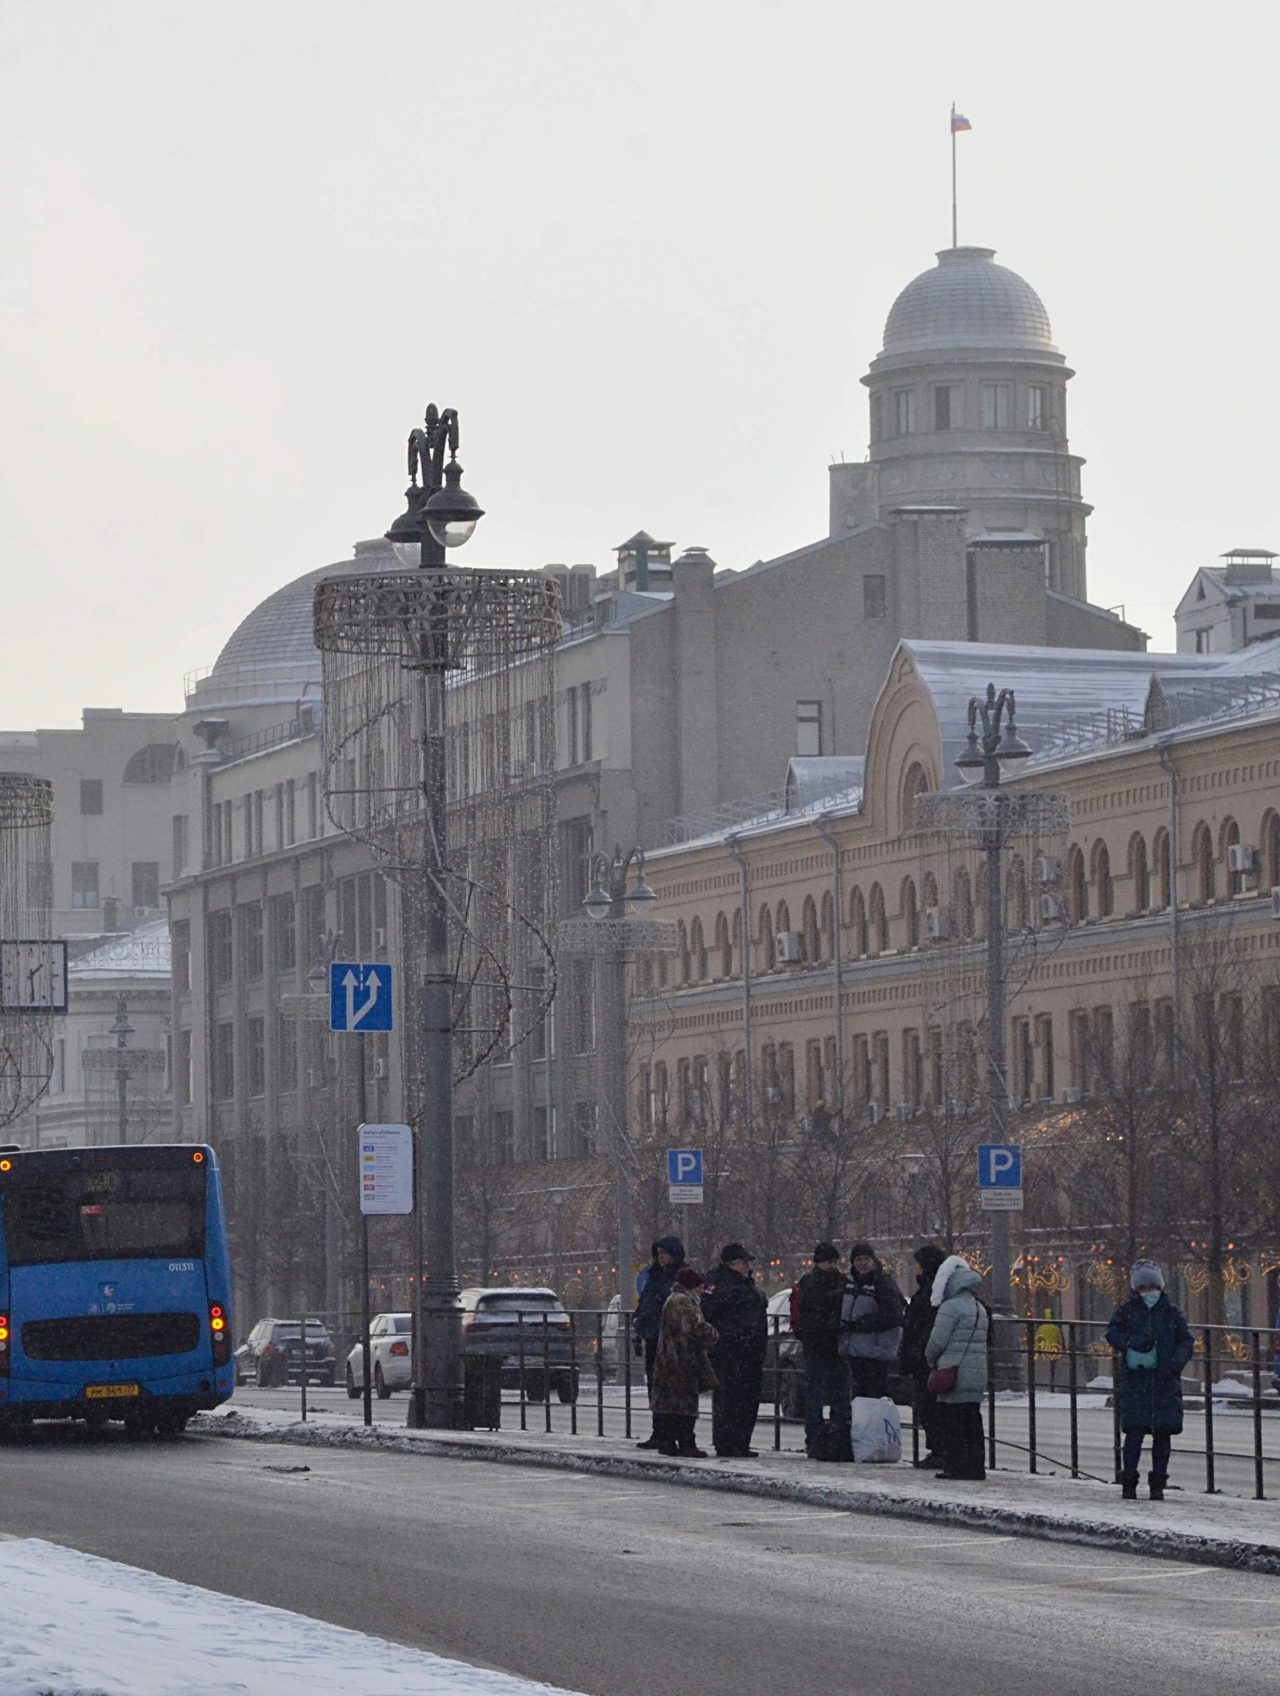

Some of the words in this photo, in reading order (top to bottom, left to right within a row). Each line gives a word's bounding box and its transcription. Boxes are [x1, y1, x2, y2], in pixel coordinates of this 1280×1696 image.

[677, 1152, 697, 1182] P
[989, 1149, 1014, 1184] P
[168, 1262, 194, 1272] 011311
